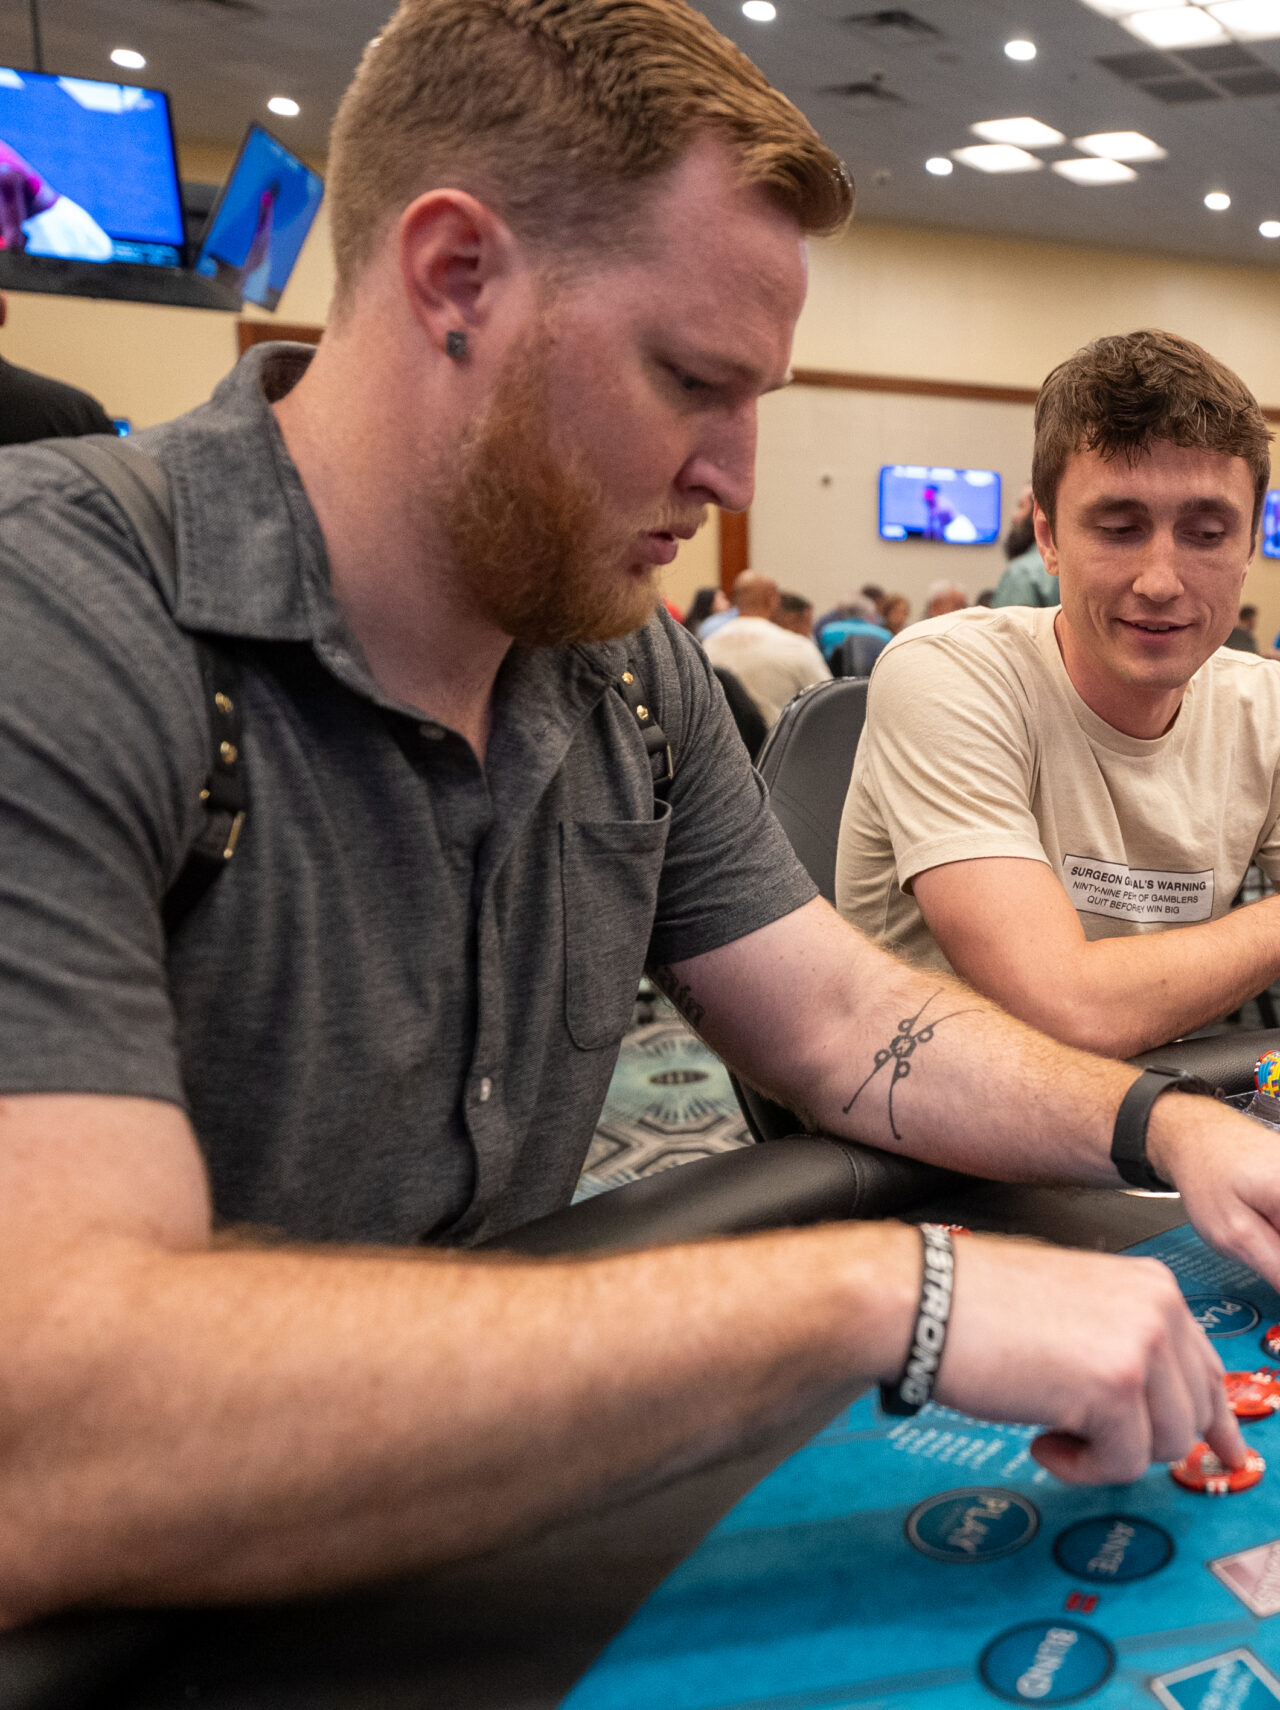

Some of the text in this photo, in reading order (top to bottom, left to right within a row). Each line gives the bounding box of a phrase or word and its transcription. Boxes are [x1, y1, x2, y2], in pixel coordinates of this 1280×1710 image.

[1070, 866, 1123, 885] SURGEON
[1157, 880, 1207, 892] WARNING
[1072, 881, 1121, 898] NINTY-NINE
[1138, 894, 1149, 903] OF
[1151, 895, 1199, 904] GAMBLERS
[1087, 895, 1108, 906] QUIT
[1146, 905, 1163, 914] WIN
[1165, 906, 1180, 914] BIG
[1196, 1300, 1243, 1328] PLA
